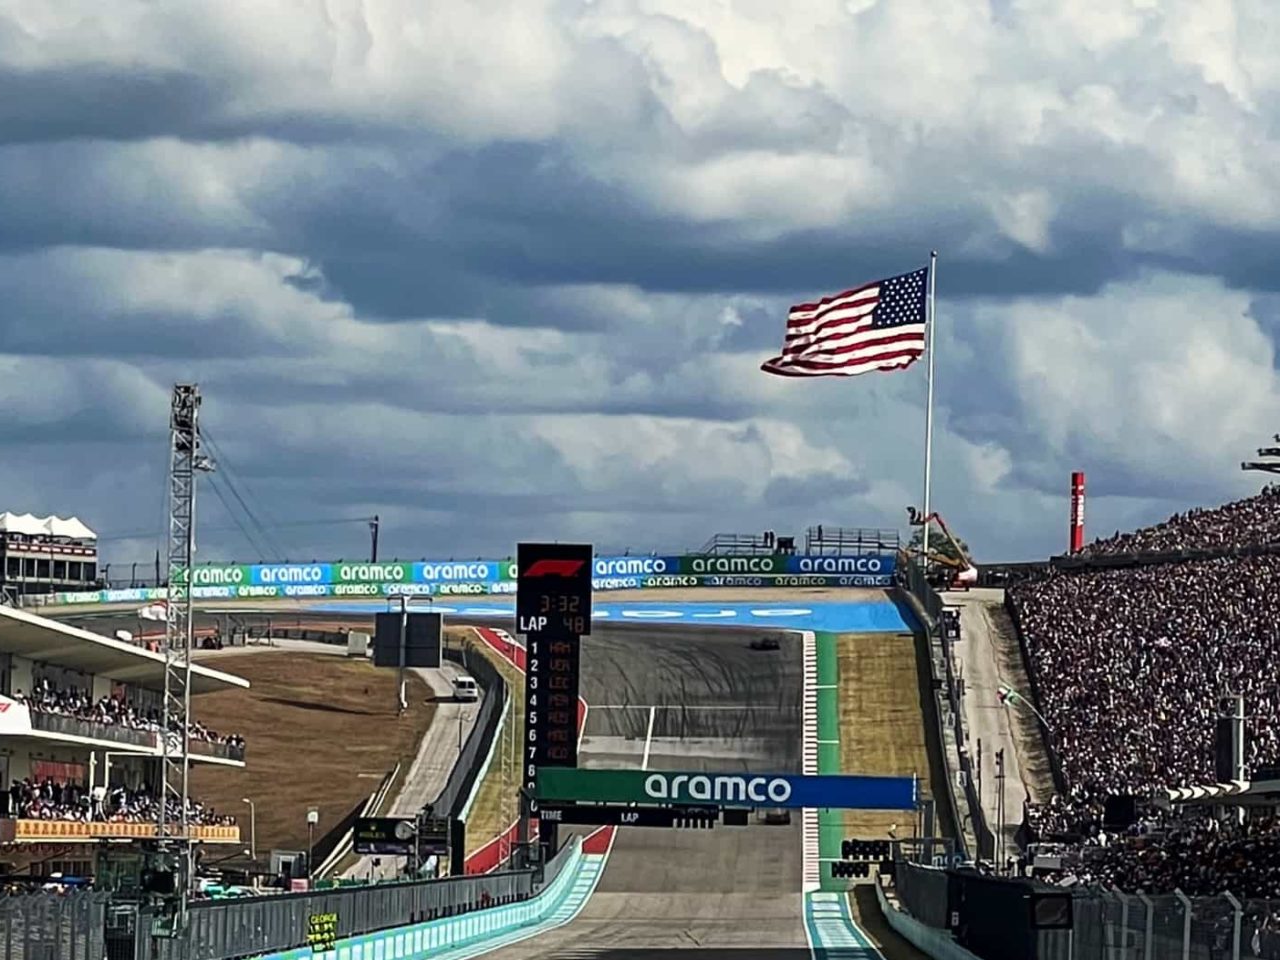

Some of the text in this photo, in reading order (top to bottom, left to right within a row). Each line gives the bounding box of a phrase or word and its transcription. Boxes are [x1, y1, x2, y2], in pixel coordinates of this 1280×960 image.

[595, 558, 666, 575] aramco
[692, 556, 773, 572] aramco
[799, 557, 881, 573] aramco
[260, 565, 322, 582] aramco
[341, 564, 404, 580] aramco
[423, 564, 489, 580] aramco
[646, 576, 697, 586] aramco
[711, 576, 762, 586] aramco
[775, 576, 826, 586] aramco
[839, 576, 891, 586] aramco
[520, 616, 547, 631] LAP
[531, 642, 538, 654] 1
[530, 659, 538, 671] 2
[530, 677, 538, 689] 3
[529, 694, 537, 706] 4
[529, 711, 537, 724] 5
[529, 730, 536, 741] 6
[528, 747, 536, 759] 7
[645, 773, 791, 802] aramco
[540, 810, 562, 820] TIME
[621, 812, 639, 823] LAP
